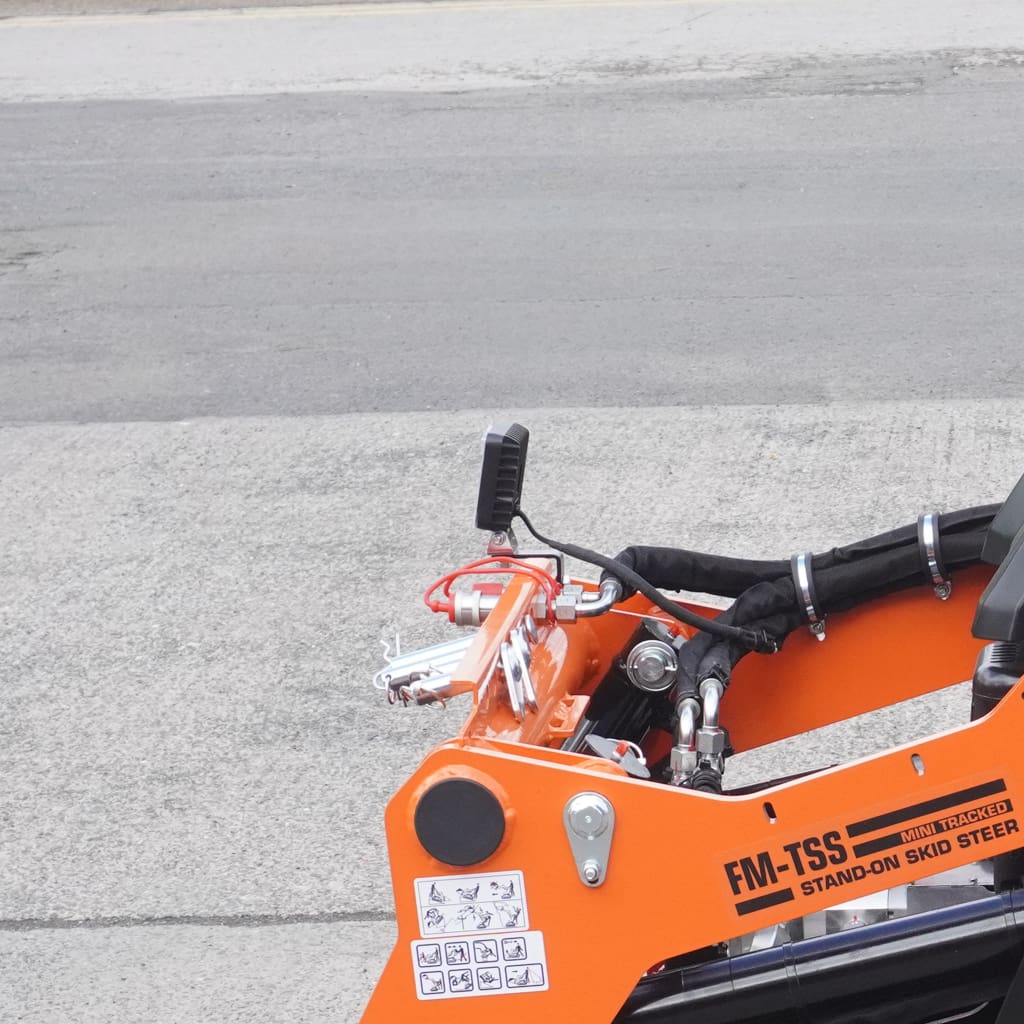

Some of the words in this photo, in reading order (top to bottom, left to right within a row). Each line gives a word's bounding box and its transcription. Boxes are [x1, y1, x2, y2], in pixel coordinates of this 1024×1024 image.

[900, 825, 937, 843] MINI
[940, 801, 1009, 830] TRACKED
[724, 830, 848, 895] FM-TSS
[801, 854, 899, 896] STAND-ON
[907, 837, 952, 864] SKID
[959, 818, 1020, 848] STEER
